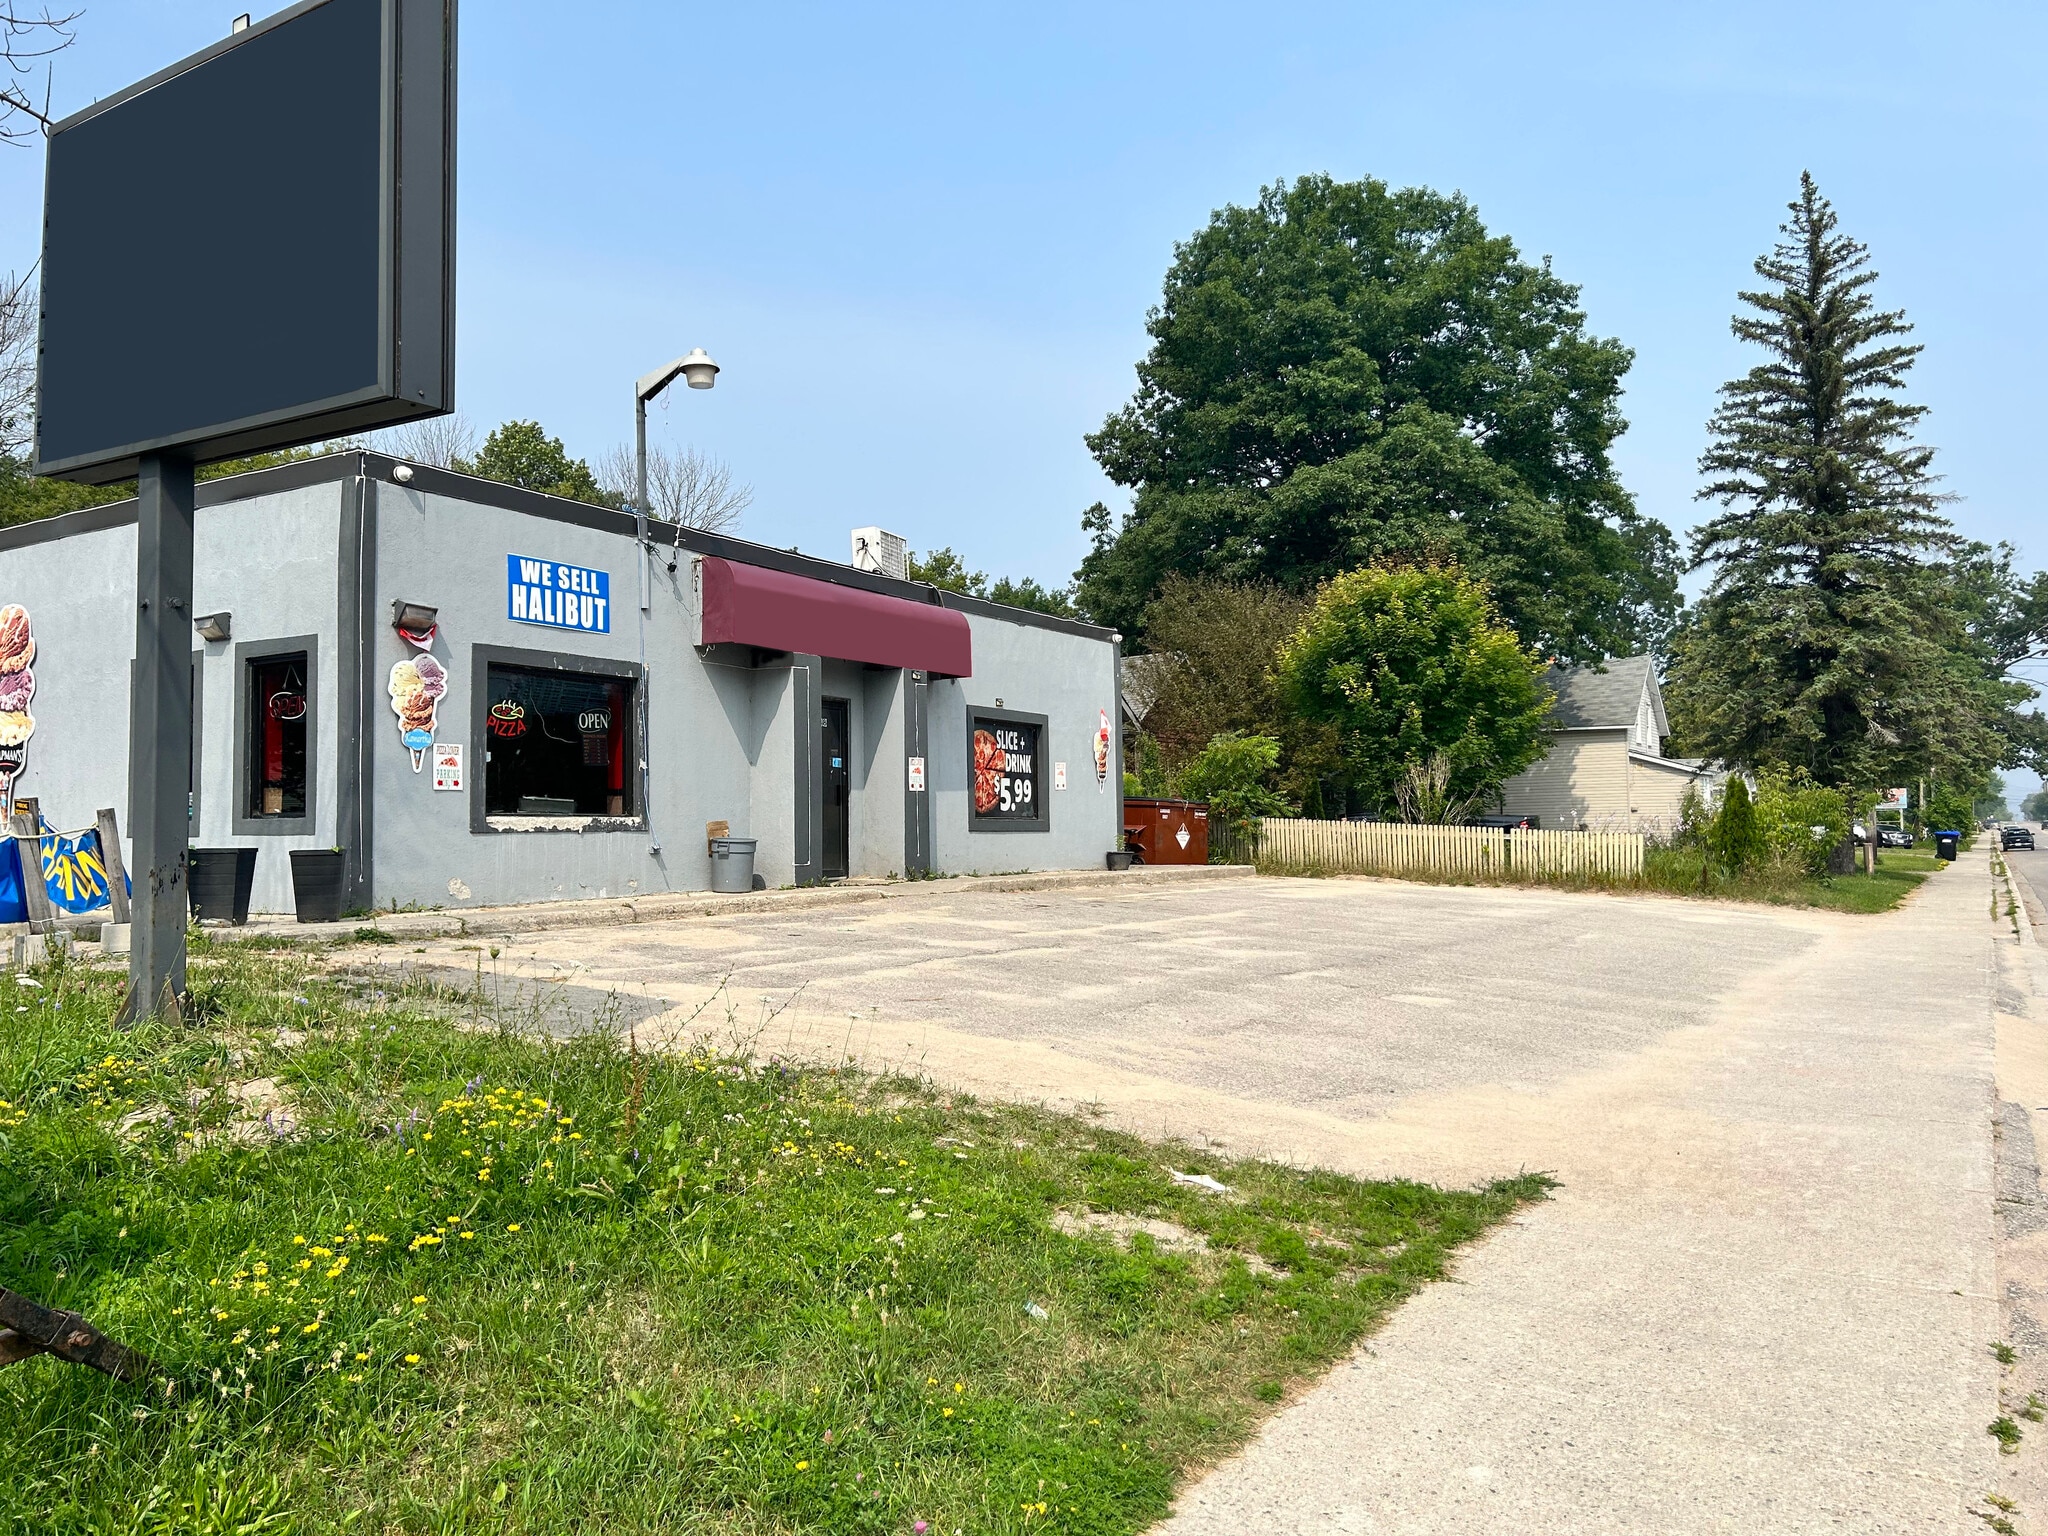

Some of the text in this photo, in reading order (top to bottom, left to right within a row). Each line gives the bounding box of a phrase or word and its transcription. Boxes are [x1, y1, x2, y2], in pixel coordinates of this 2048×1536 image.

[520, 559, 600, 595] WE SELL
[512, 584, 606, 630] HALIBUT
[271, 696, 304, 717] OPEN
[486, 715, 527, 737] PIZZA
[579, 713, 608, 729] OPEN
[996, 730, 1018, 750] SLICE
[436, 768, 460, 779] PARKING
[1005, 753, 1032, 773] DRINK
[994, 773, 1032, 811] $5.99
